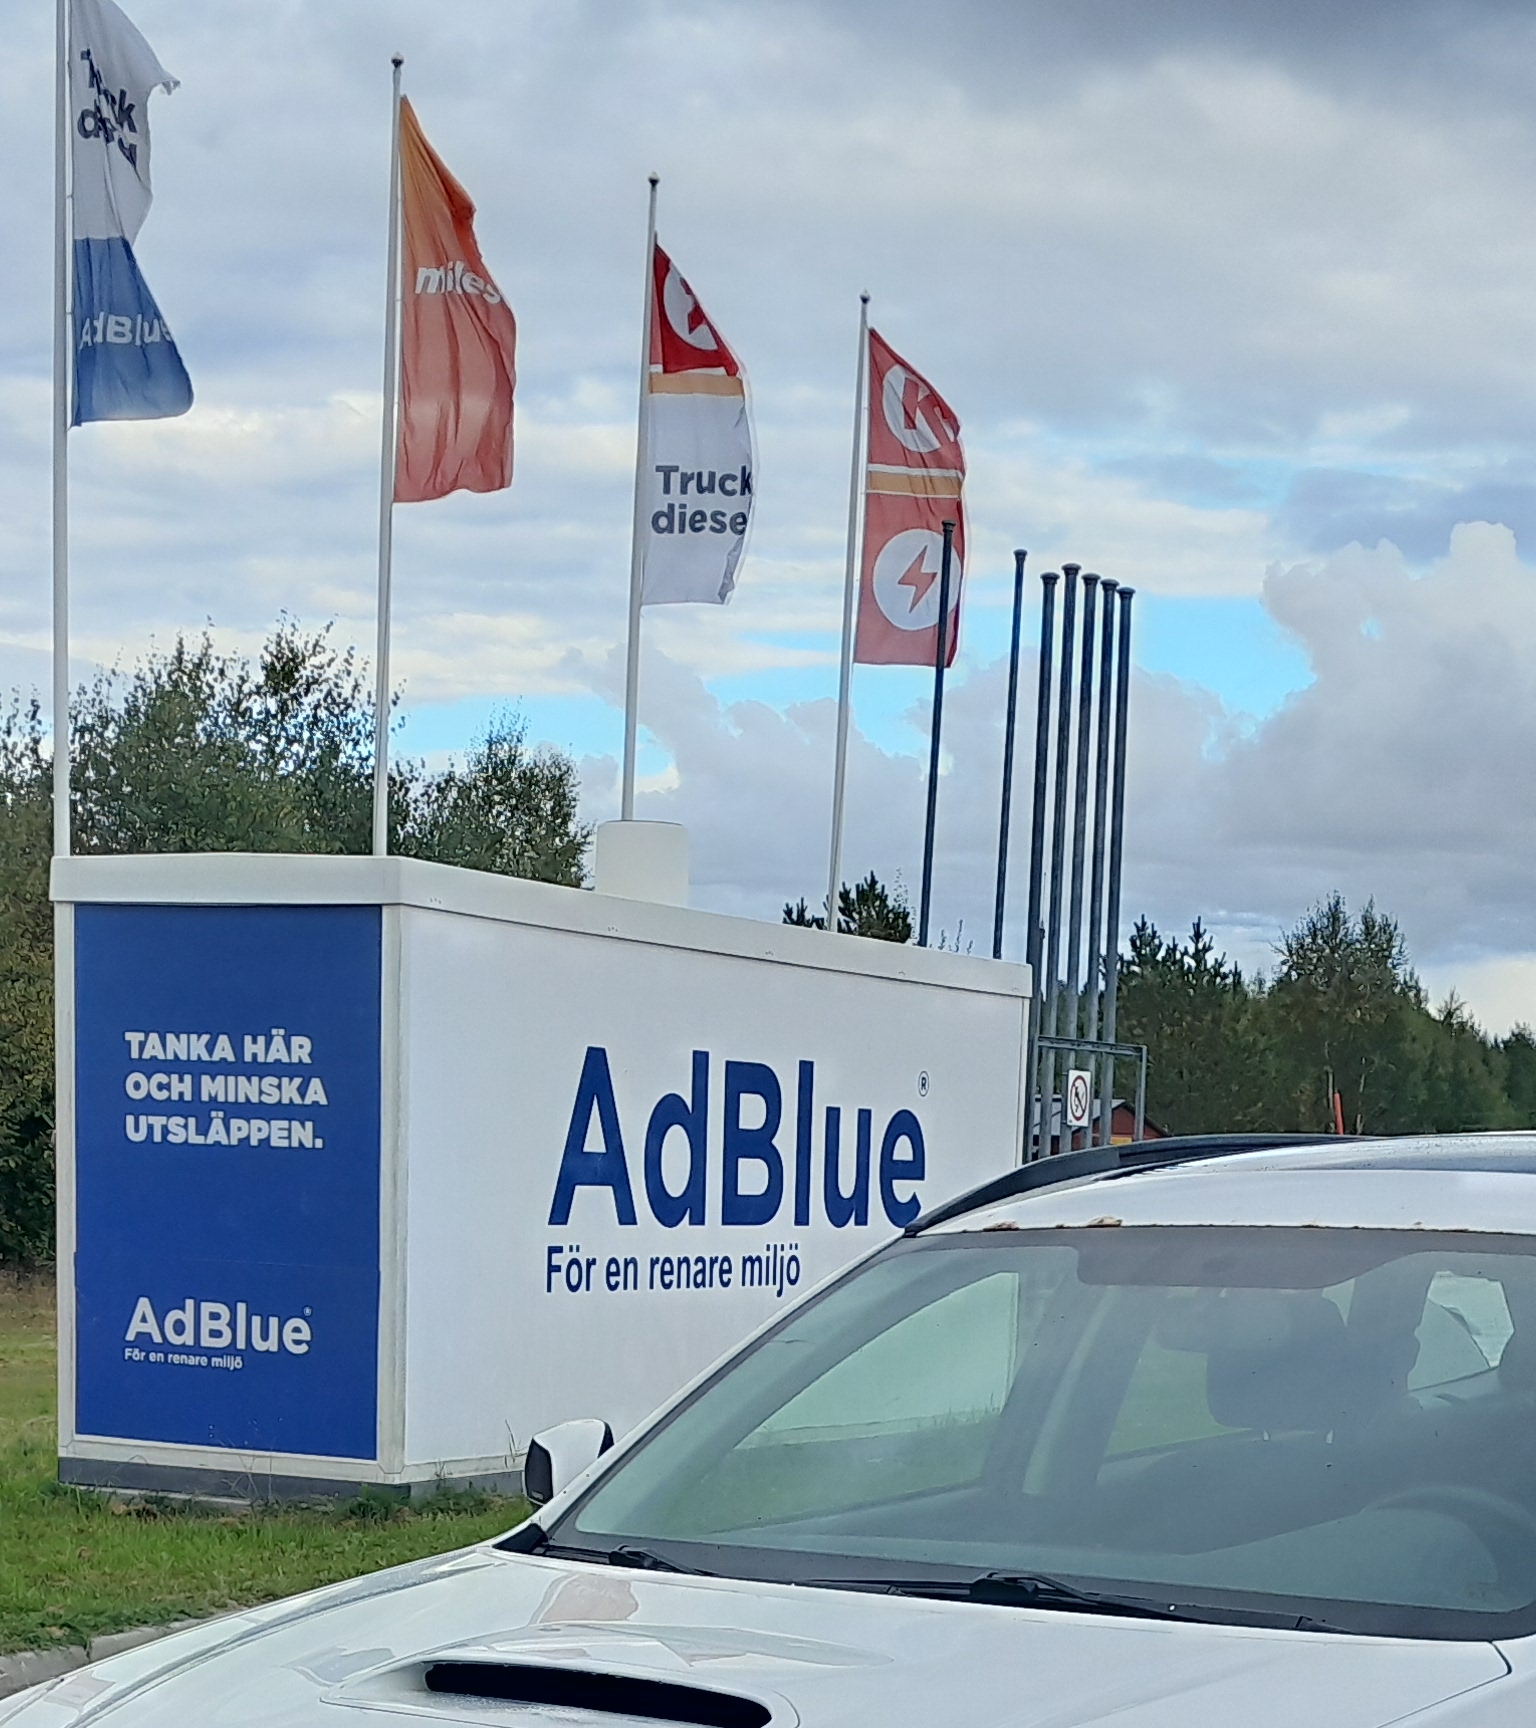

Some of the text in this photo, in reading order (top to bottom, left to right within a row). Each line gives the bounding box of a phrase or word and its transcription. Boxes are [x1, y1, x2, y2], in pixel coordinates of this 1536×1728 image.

[414, 260, 501, 304] miles
[655, 465, 752, 497] Truck
[124, 1028, 313, 1064] TANKA HÄR
[125, 1071, 329, 1106] OCH MINSKA
[125, 1110, 324, 1149] UTSLÄPPEN.
[546, 1242, 801, 1298] För en renare miljö
[124, 1348, 244, 1371] För en renare miljö
